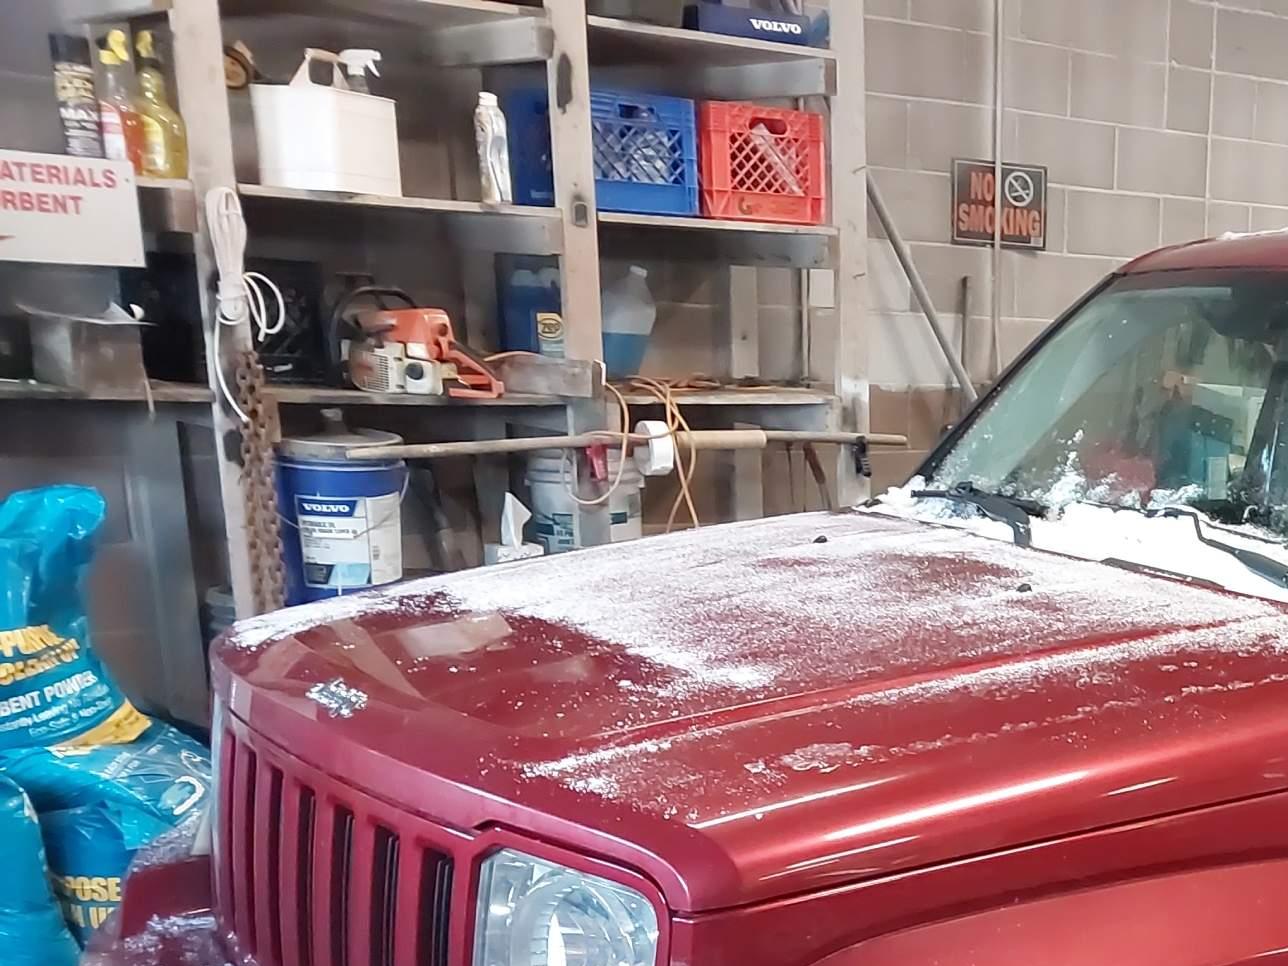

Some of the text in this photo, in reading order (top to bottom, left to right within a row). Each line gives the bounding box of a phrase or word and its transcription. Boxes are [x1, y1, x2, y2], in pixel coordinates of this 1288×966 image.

[748, 18, 802, 35] VOLVO
[970, 171, 995, 202] NO
[301, 502, 350, 513] VOLVO
